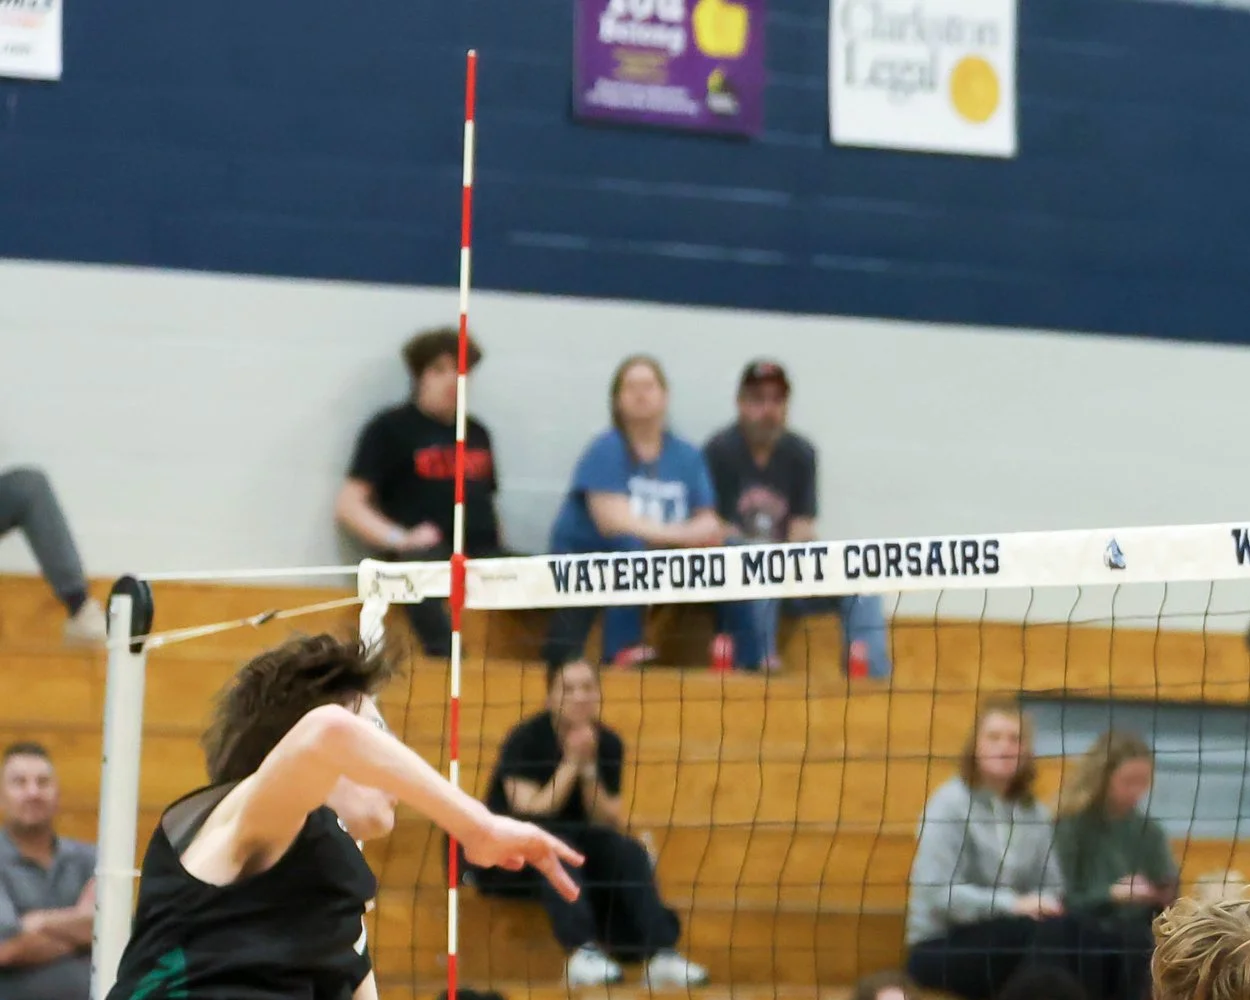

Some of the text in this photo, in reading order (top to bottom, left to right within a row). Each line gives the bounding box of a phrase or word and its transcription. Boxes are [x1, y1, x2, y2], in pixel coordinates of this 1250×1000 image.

[548, 539, 1001, 593] WATERFORD MOTT CORSAIRS
